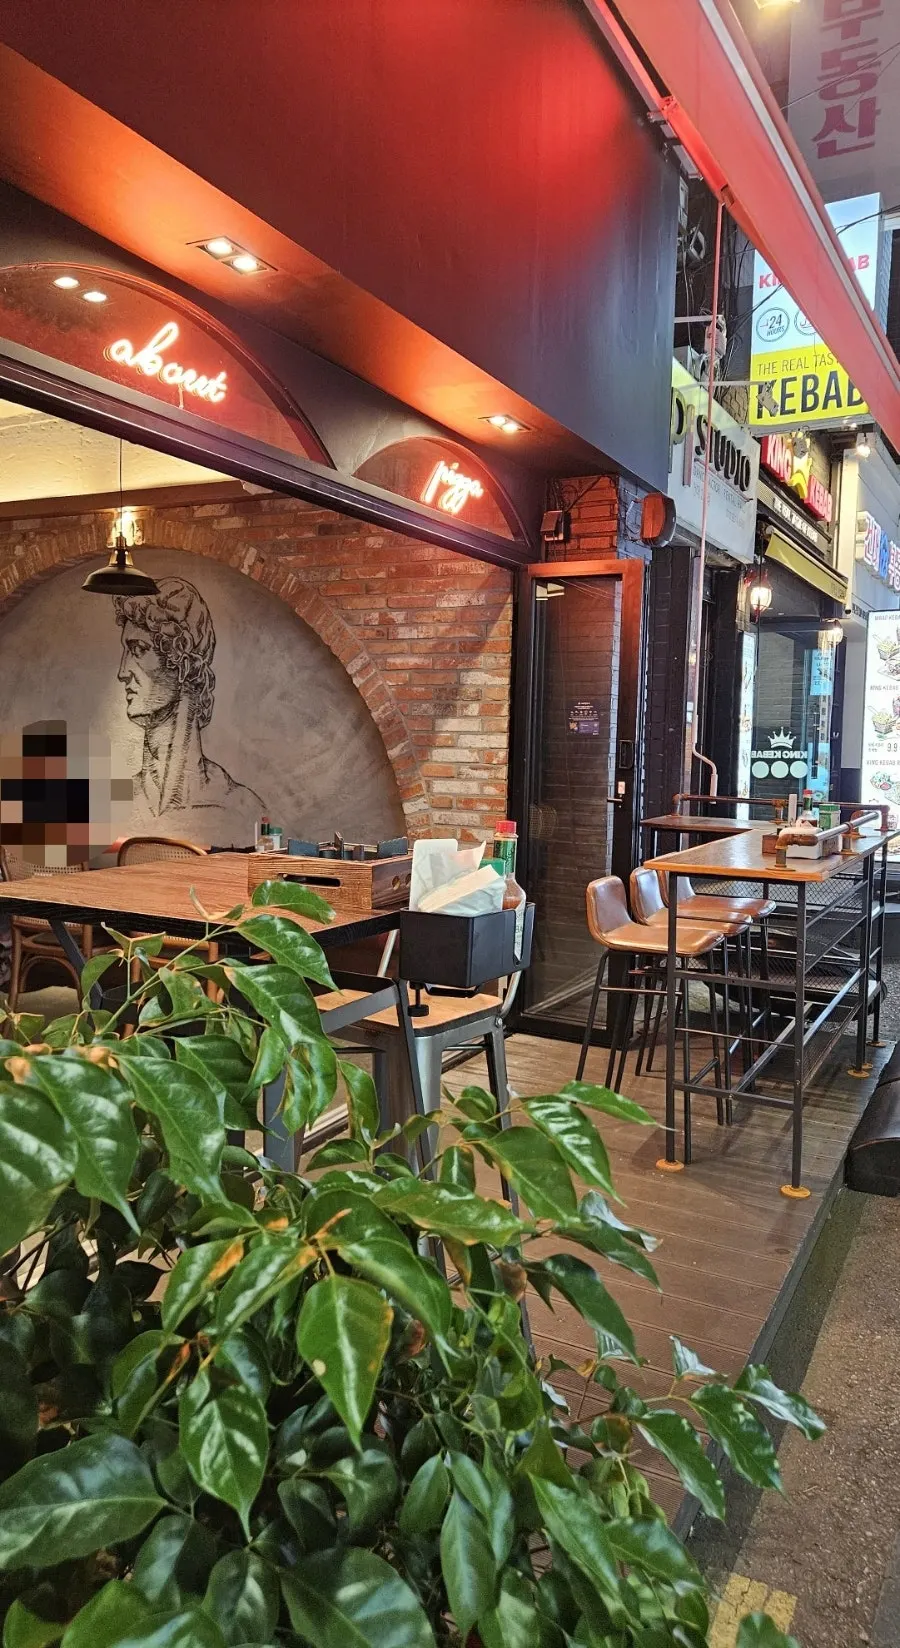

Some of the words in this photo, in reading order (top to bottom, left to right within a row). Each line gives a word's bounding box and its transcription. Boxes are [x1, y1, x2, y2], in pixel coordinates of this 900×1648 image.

[769, 313, 782, 330] 24
[106, 321, 229, 404] about
[757, 363, 778, 376] THE
[781, 355, 810, 373] REAL
[813, 352, 841, 368] TAS
[694, 414, 752, 493] STUDIO
[766, 433, 792, 485] KING
[420, 460, 484, 514] pizza
[808, 475, 833, 523] KEBAB
